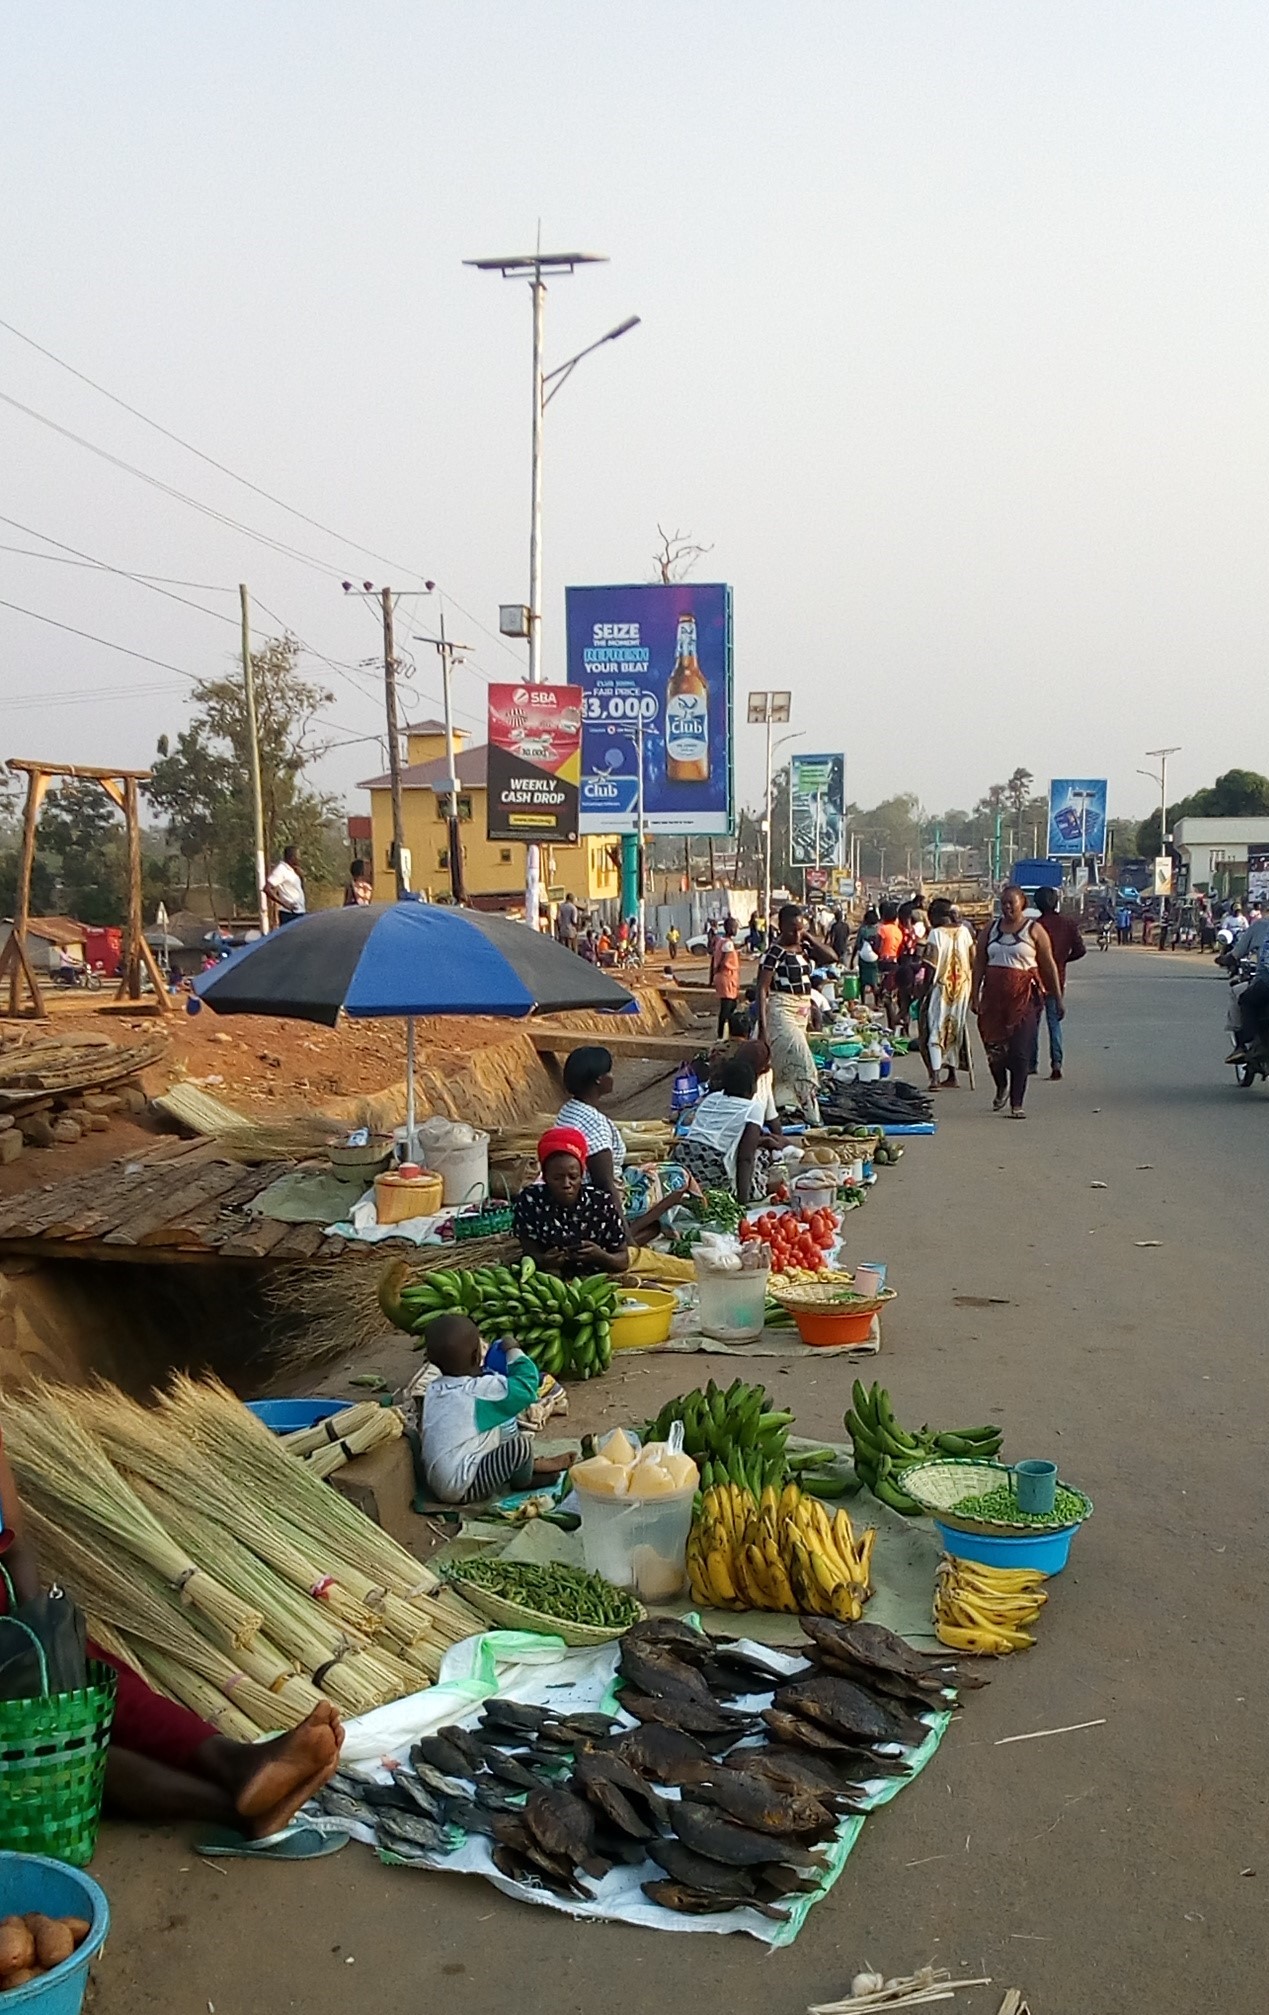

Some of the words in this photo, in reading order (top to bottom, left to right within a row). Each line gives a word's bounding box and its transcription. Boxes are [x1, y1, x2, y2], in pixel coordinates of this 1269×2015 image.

[593, 623, 640, 639] SEIZE
[584, 662, 619, 673] YOUR
[621, 662, 649, 673] BEAT
[531, 692, 557, 704] SBA
[593, 687, 613, 696] FAIR
[615, 687, 641, 696] PRICE
[671, 719, 703, 734] Club
[510, 778, 557, 791] WEEKLY
[584, 783, 618, 798] Club
[501, 790, 532, 803] CASH
[533, 792, 566, 805] DROP
